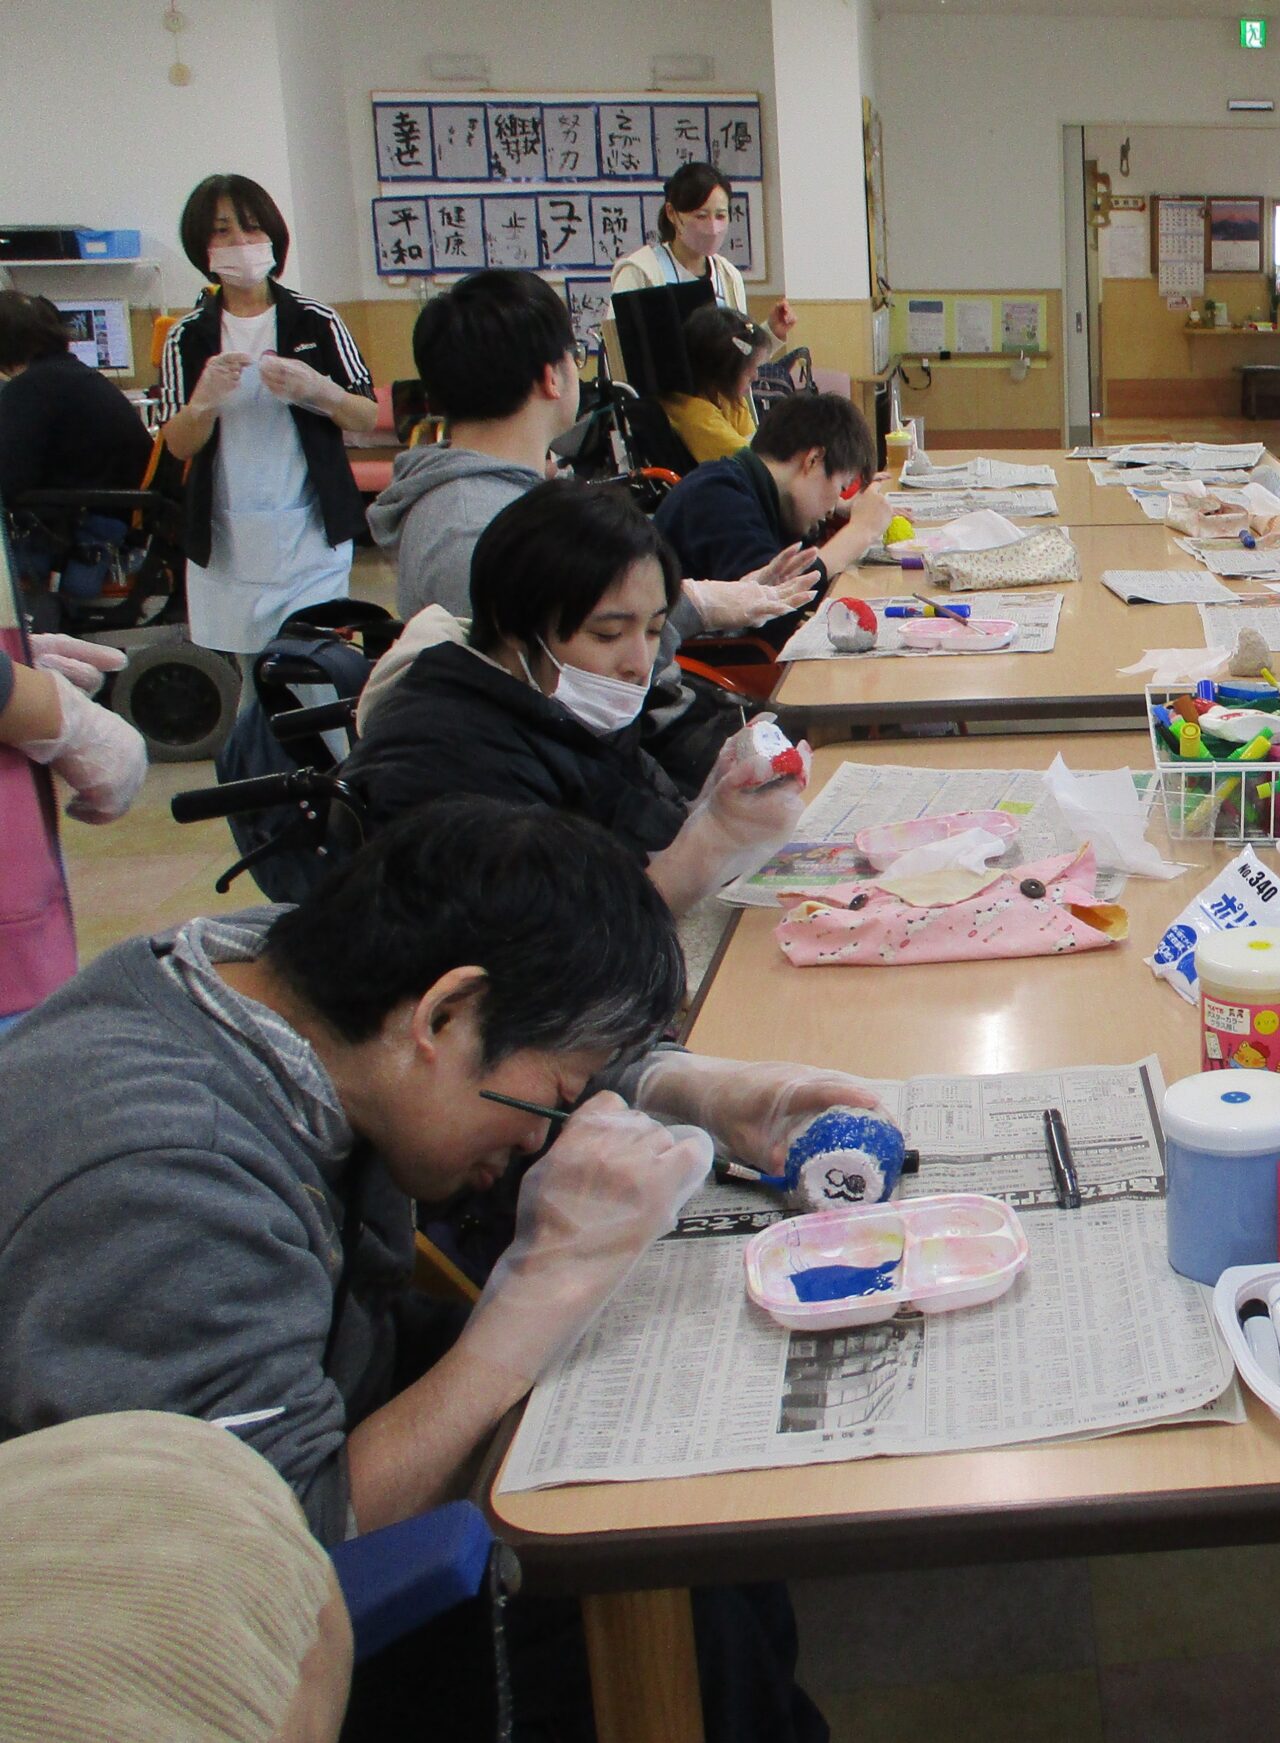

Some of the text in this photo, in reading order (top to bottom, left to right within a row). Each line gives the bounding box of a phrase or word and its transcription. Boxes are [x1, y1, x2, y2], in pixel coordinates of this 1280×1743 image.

[558, 114, 579, 171] 努力
[388, 206, 423, 265] 平和
[438, 206, 468, 257] 健康
